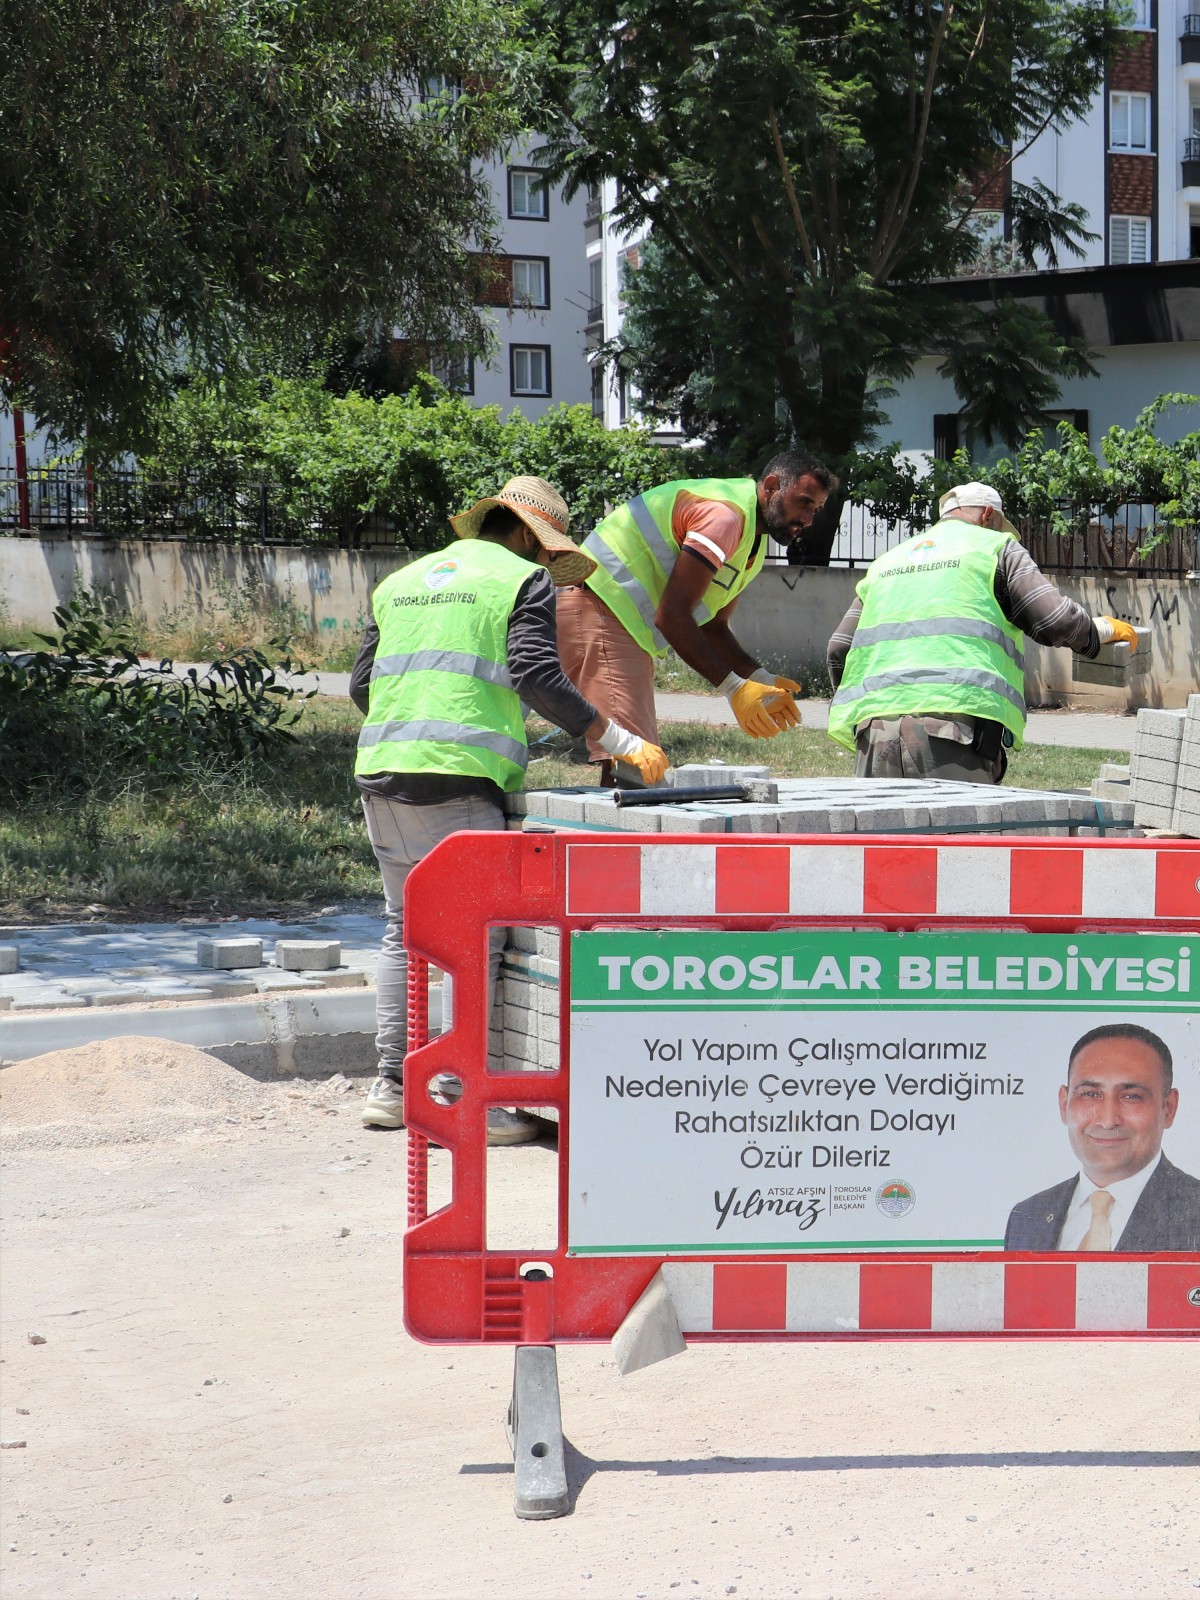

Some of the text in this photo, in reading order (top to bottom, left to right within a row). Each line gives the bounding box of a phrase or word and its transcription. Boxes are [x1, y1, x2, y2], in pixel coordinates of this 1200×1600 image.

[917, 558, 961, 573] BELEDİYESİ
[430, 591, 478, 605] BELEDİYESİ
[598, 944, 1192, 992] TOROSLAR BELEDİYESİ
[643, 1037, 987, 1067] Yol Yapım Çalışmalarımız
[605, 1071, 1024, 1104] Nedeniyle Çevreye Verdiğimiz
[675, 1108, 956, 1136] Rahatsızlıktan Dolayı
[740, 1140, 891, 1169] Özür Dileriz
[767, 1187, 795, 1196] ATSIZ
[833, 1186, 872, 1194] TOROSLAR
[833, 1194, 868, 1202] BELEDİYE
[714, 1186, 826, 1231] Yılmaz
[833, 1202, 866, 1211] BAŞKANI
